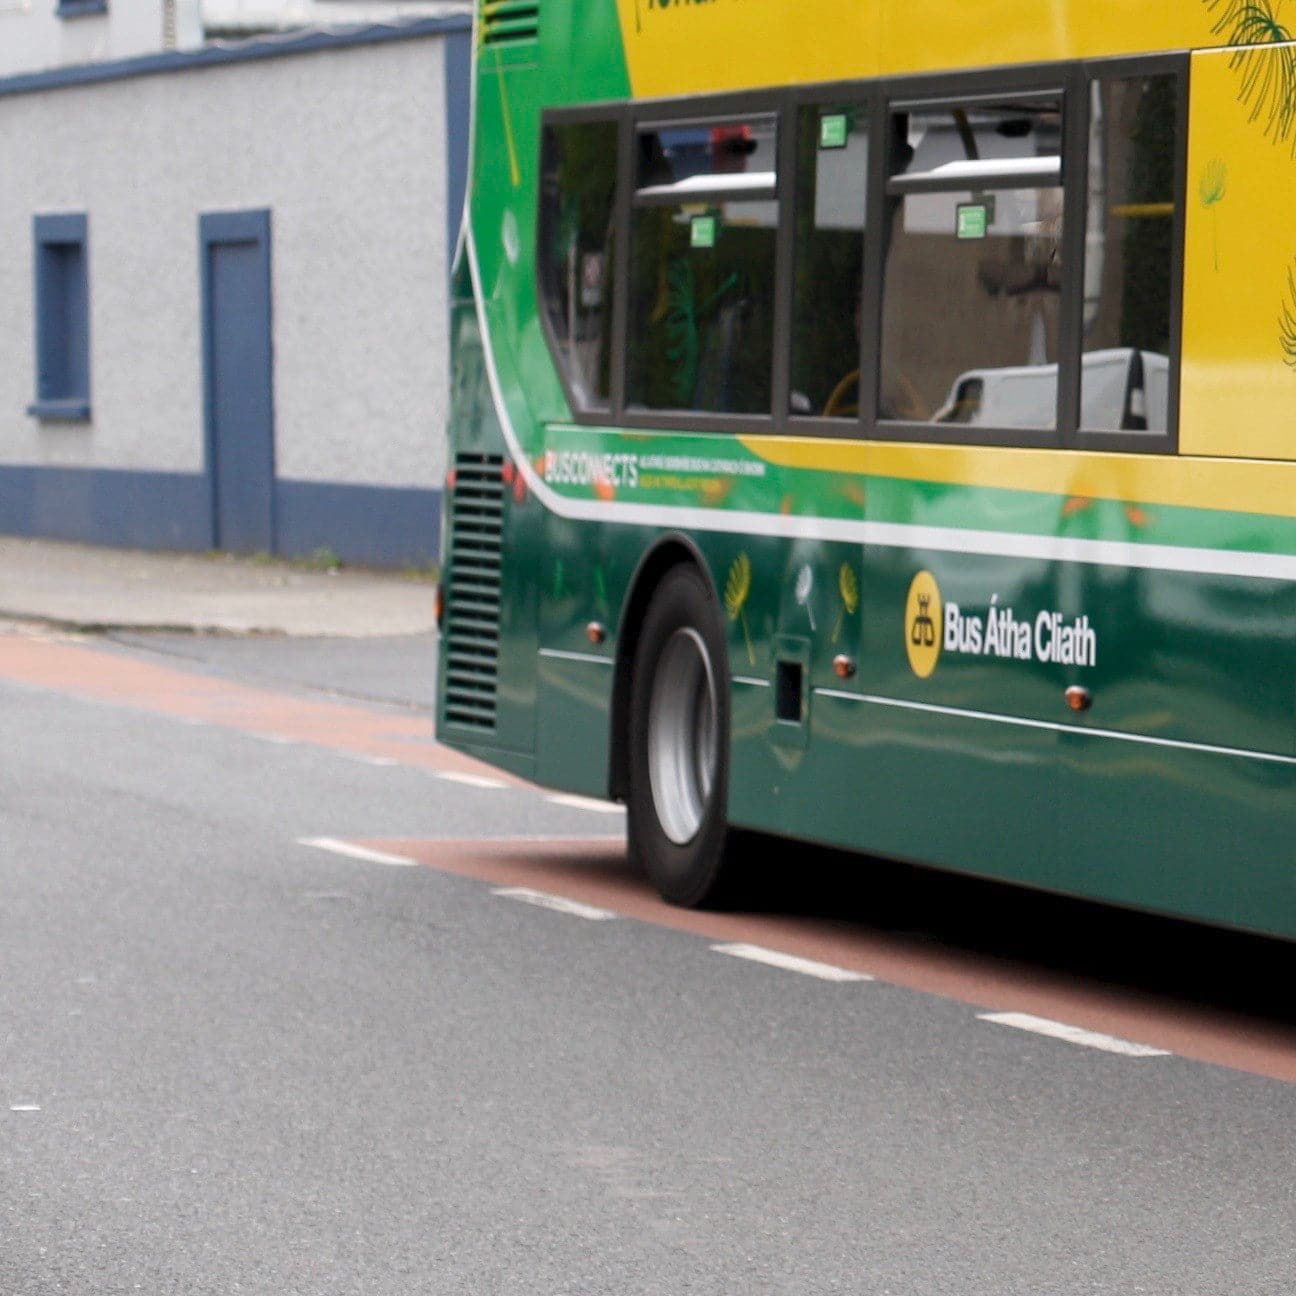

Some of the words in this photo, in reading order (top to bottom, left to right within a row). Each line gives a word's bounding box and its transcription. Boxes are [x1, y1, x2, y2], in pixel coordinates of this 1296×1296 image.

[944, 602, 983, 654] Bus
[983, 593, 1032, 659] Átha
[1034, 610, 1096, 667] Cliath
